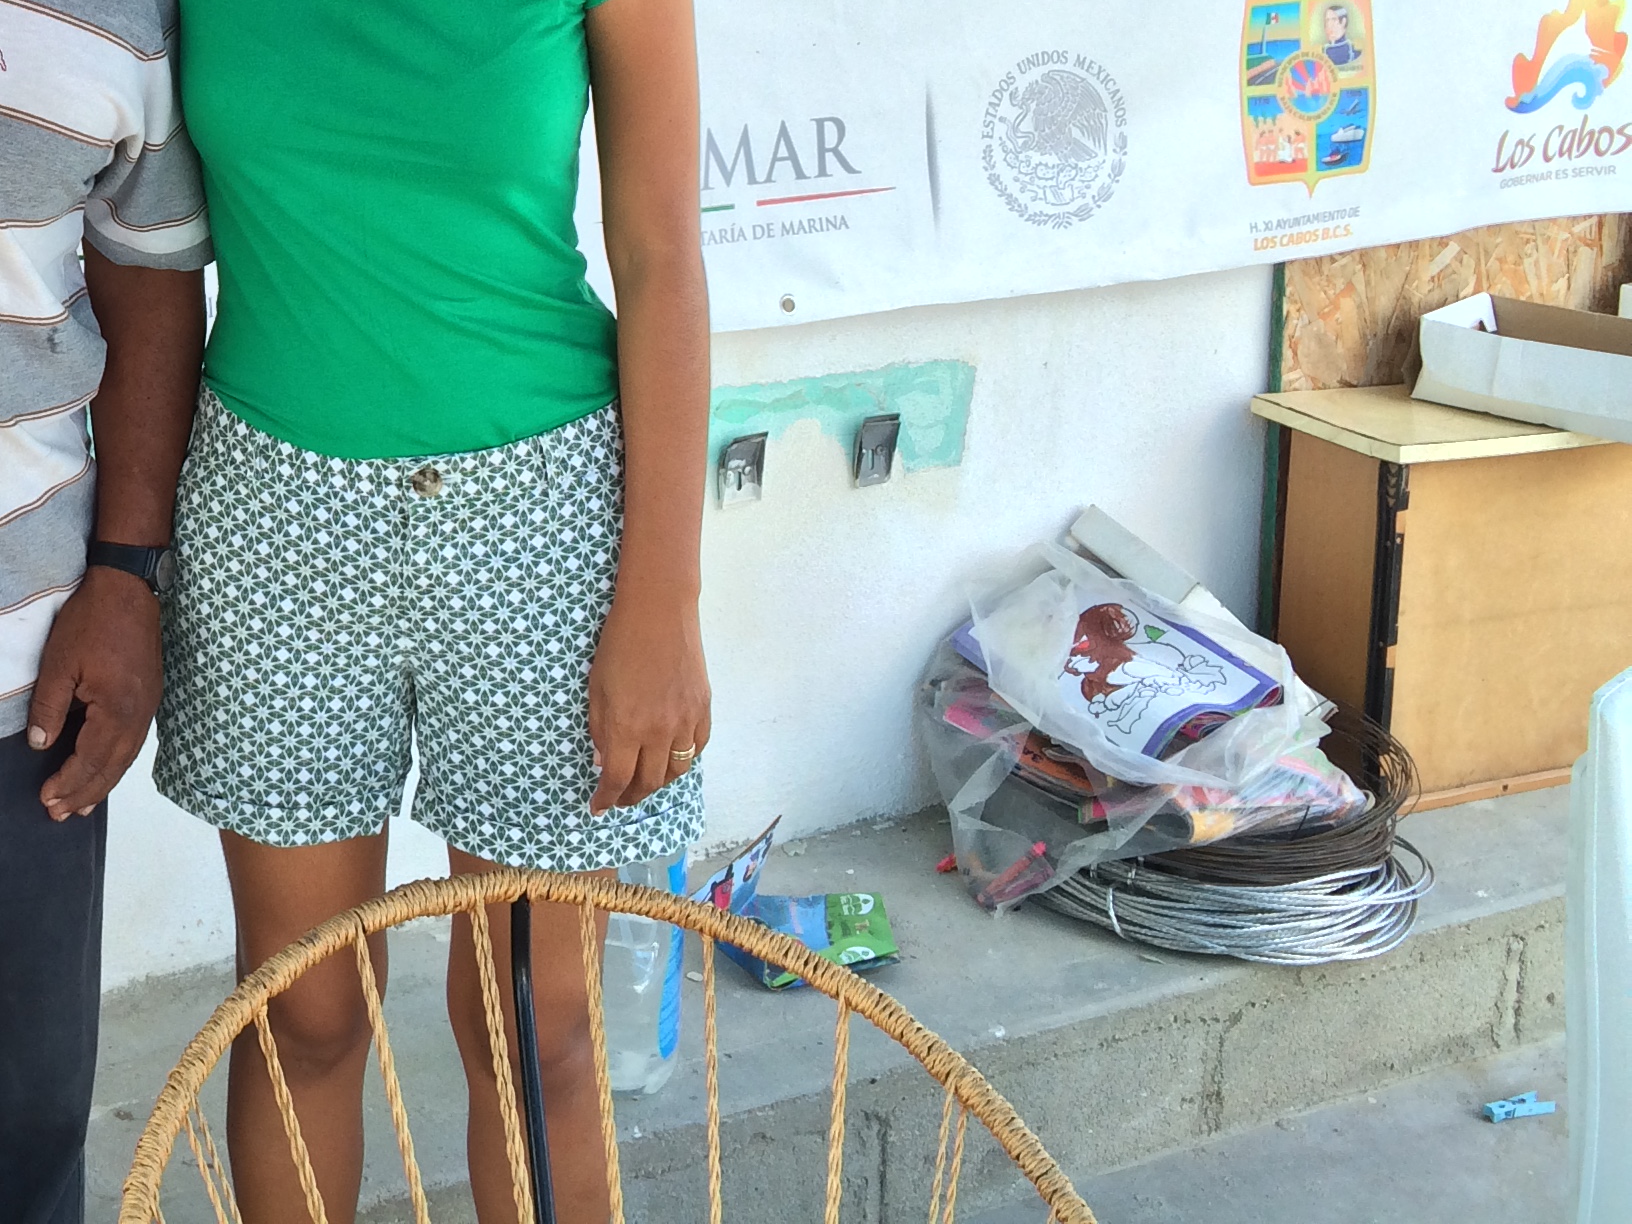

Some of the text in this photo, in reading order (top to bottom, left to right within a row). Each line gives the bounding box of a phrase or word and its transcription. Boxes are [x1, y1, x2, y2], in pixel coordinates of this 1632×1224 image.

[981, 50, 1128, 140] ESTADOS UNIDOS MEXICANOS
[701, 116, 862, 191] MAR
[1491, 113, 1632, 173] Los Cabos
[1499, 164, 1617, 189] GOBERNAR ES SERVIR
[752, 222, 776, 240] DE
[780, 214, 851, 237] MARINA
[1275, 209, 1348, 230] AYUNTAMIENTO
[1347, 206, 1361, 218] DE
[1253, 235, 1278, 251] LOS
[1279, 229, 1321, 247] CABOS
